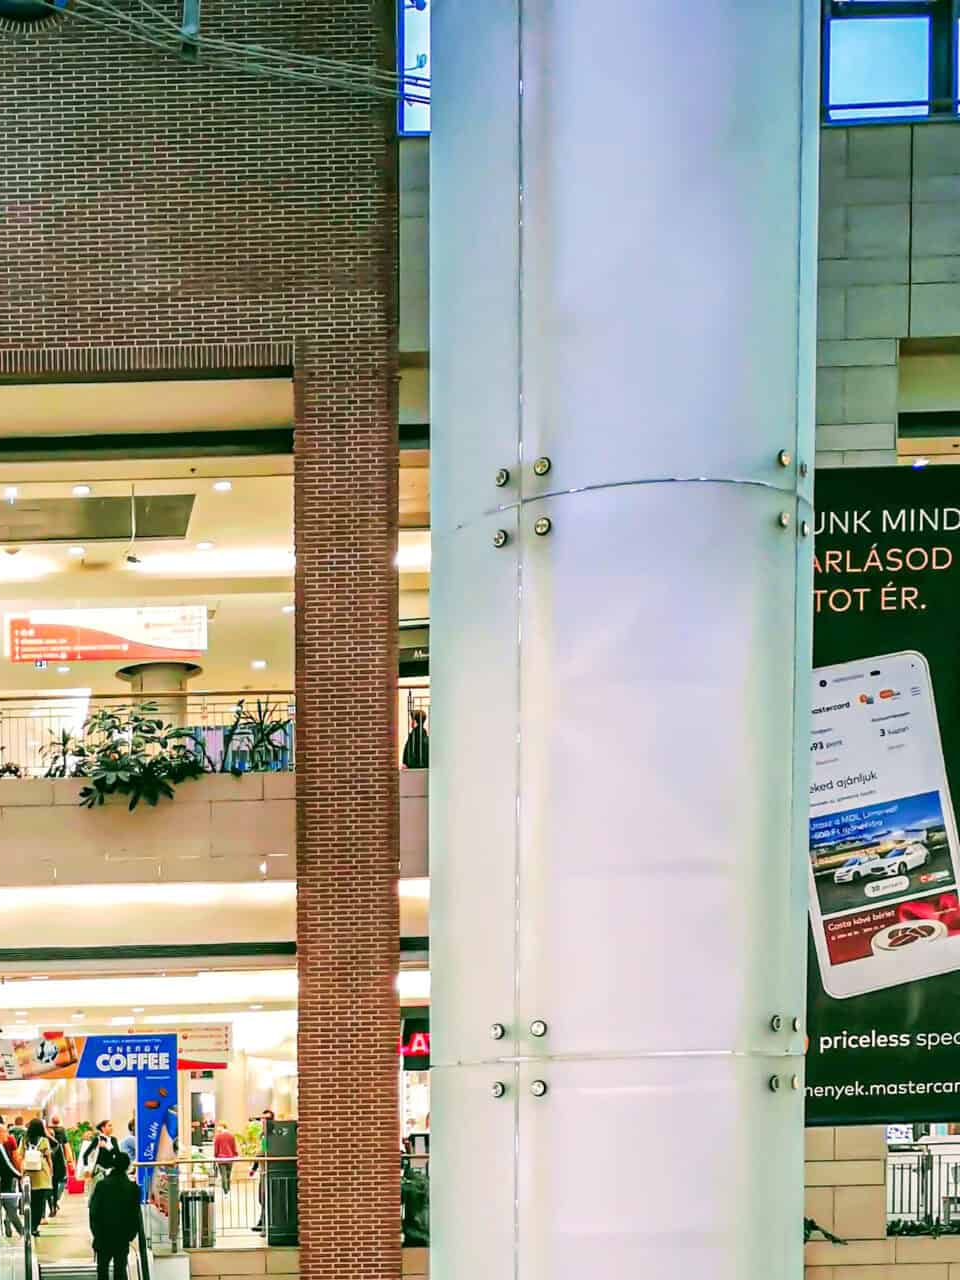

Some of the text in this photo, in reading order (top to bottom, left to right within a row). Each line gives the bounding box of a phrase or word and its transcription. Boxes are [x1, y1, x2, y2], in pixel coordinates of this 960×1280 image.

[881, 580, 927, 611] ÉR.
[820, 1029, 911, 1054] priceless
[96, 1052, 170, 1072] COFFEE
